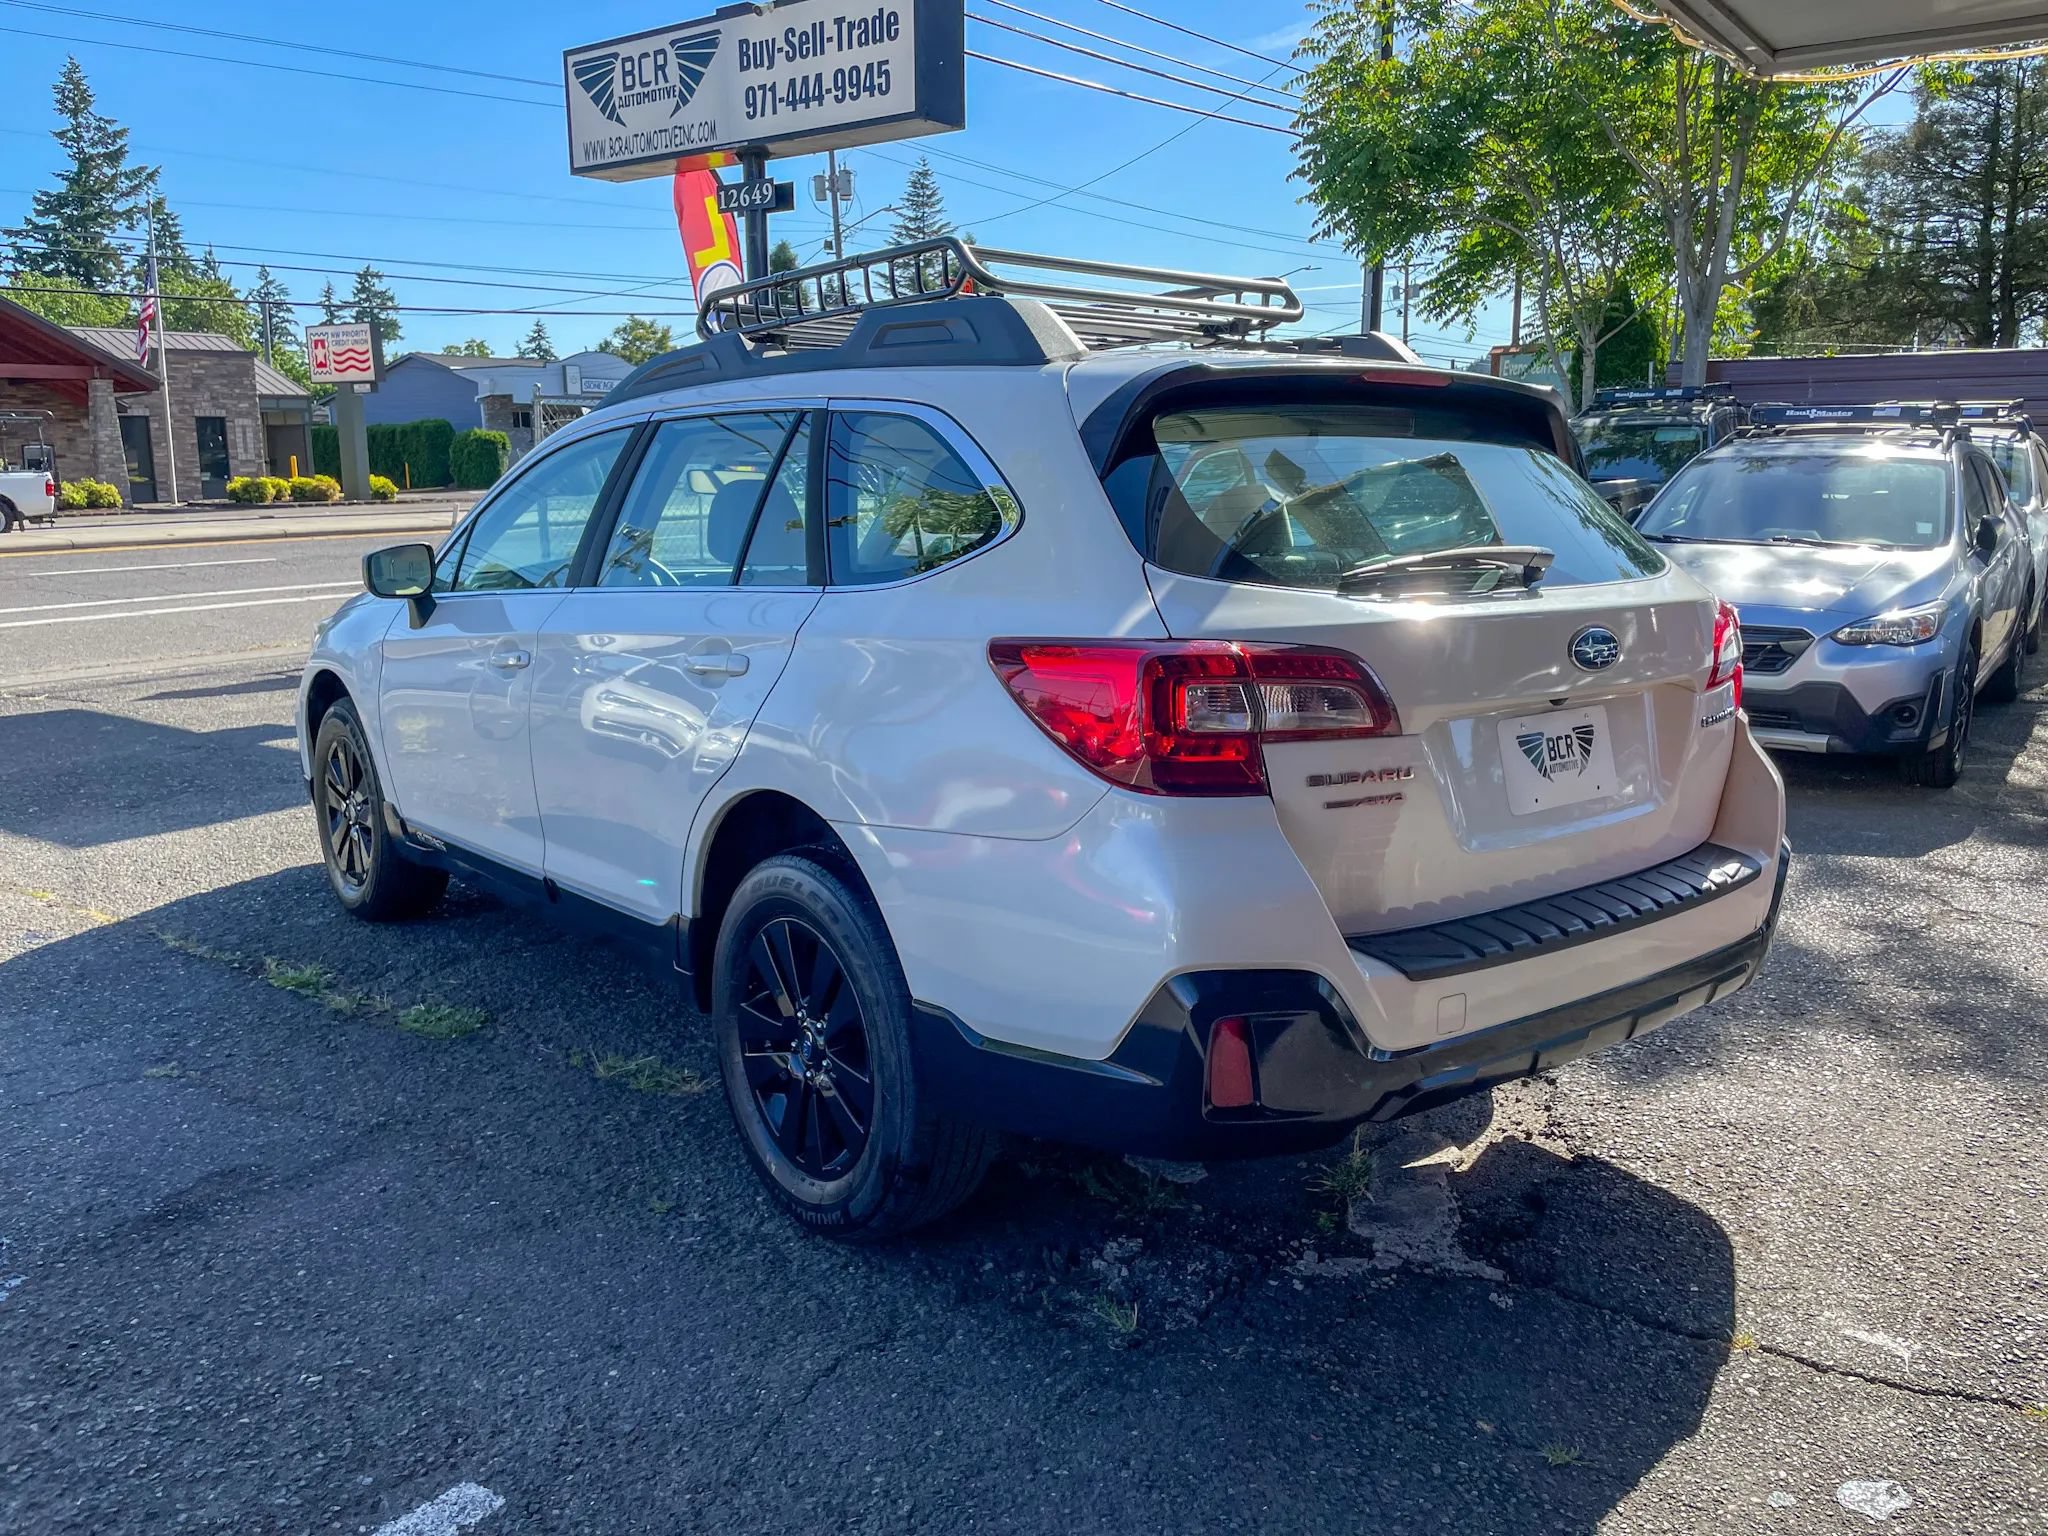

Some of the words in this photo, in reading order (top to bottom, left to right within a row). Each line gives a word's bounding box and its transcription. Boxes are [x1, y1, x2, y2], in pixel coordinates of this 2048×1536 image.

[738, 7, 900, 73] Buy-Sell-Trade
[621, 48, 669, 92] BCR
[618, 84, 677, 109] AUTOMOTIVE
[745, 59, 891, 121] 971-444-9945
[583, 119, 718, 162] WWW.BCRAUTOMOTIVEINC.COM
[719, 182, 773, 210] 12649
[331, 339, 350, 347] CREDIT
[352, 338, 369, 346] UNION
[342, 329, 368, 338] PRIORITY
[1546, 734, 1575, 762] BCR
[1307, 766, 1415, 788] SUBARU
